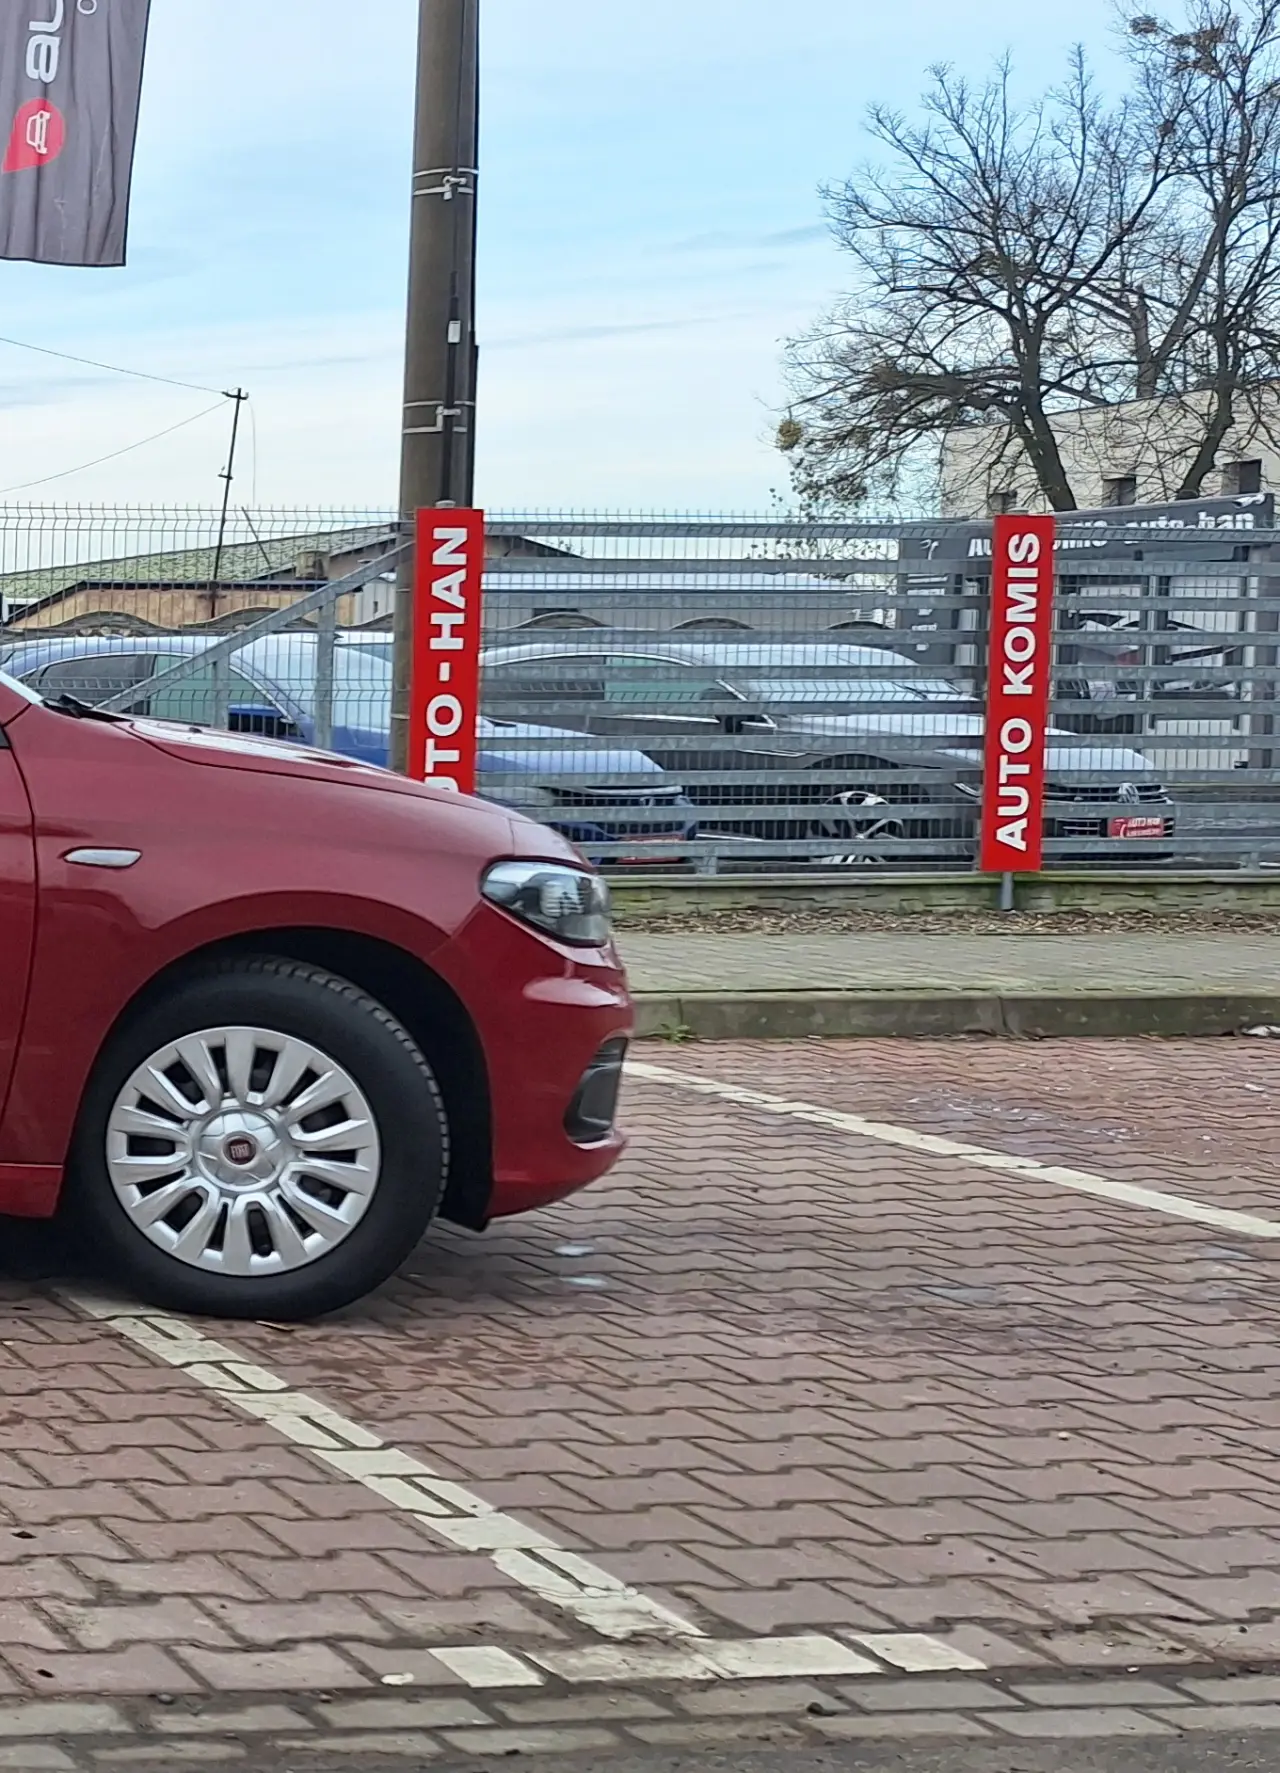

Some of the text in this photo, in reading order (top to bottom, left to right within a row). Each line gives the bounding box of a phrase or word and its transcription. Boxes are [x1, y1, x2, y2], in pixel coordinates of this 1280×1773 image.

[424, 527, 468, 793] TO-HAN
[996, 532, 1040, 852] AUTO KOMIS
